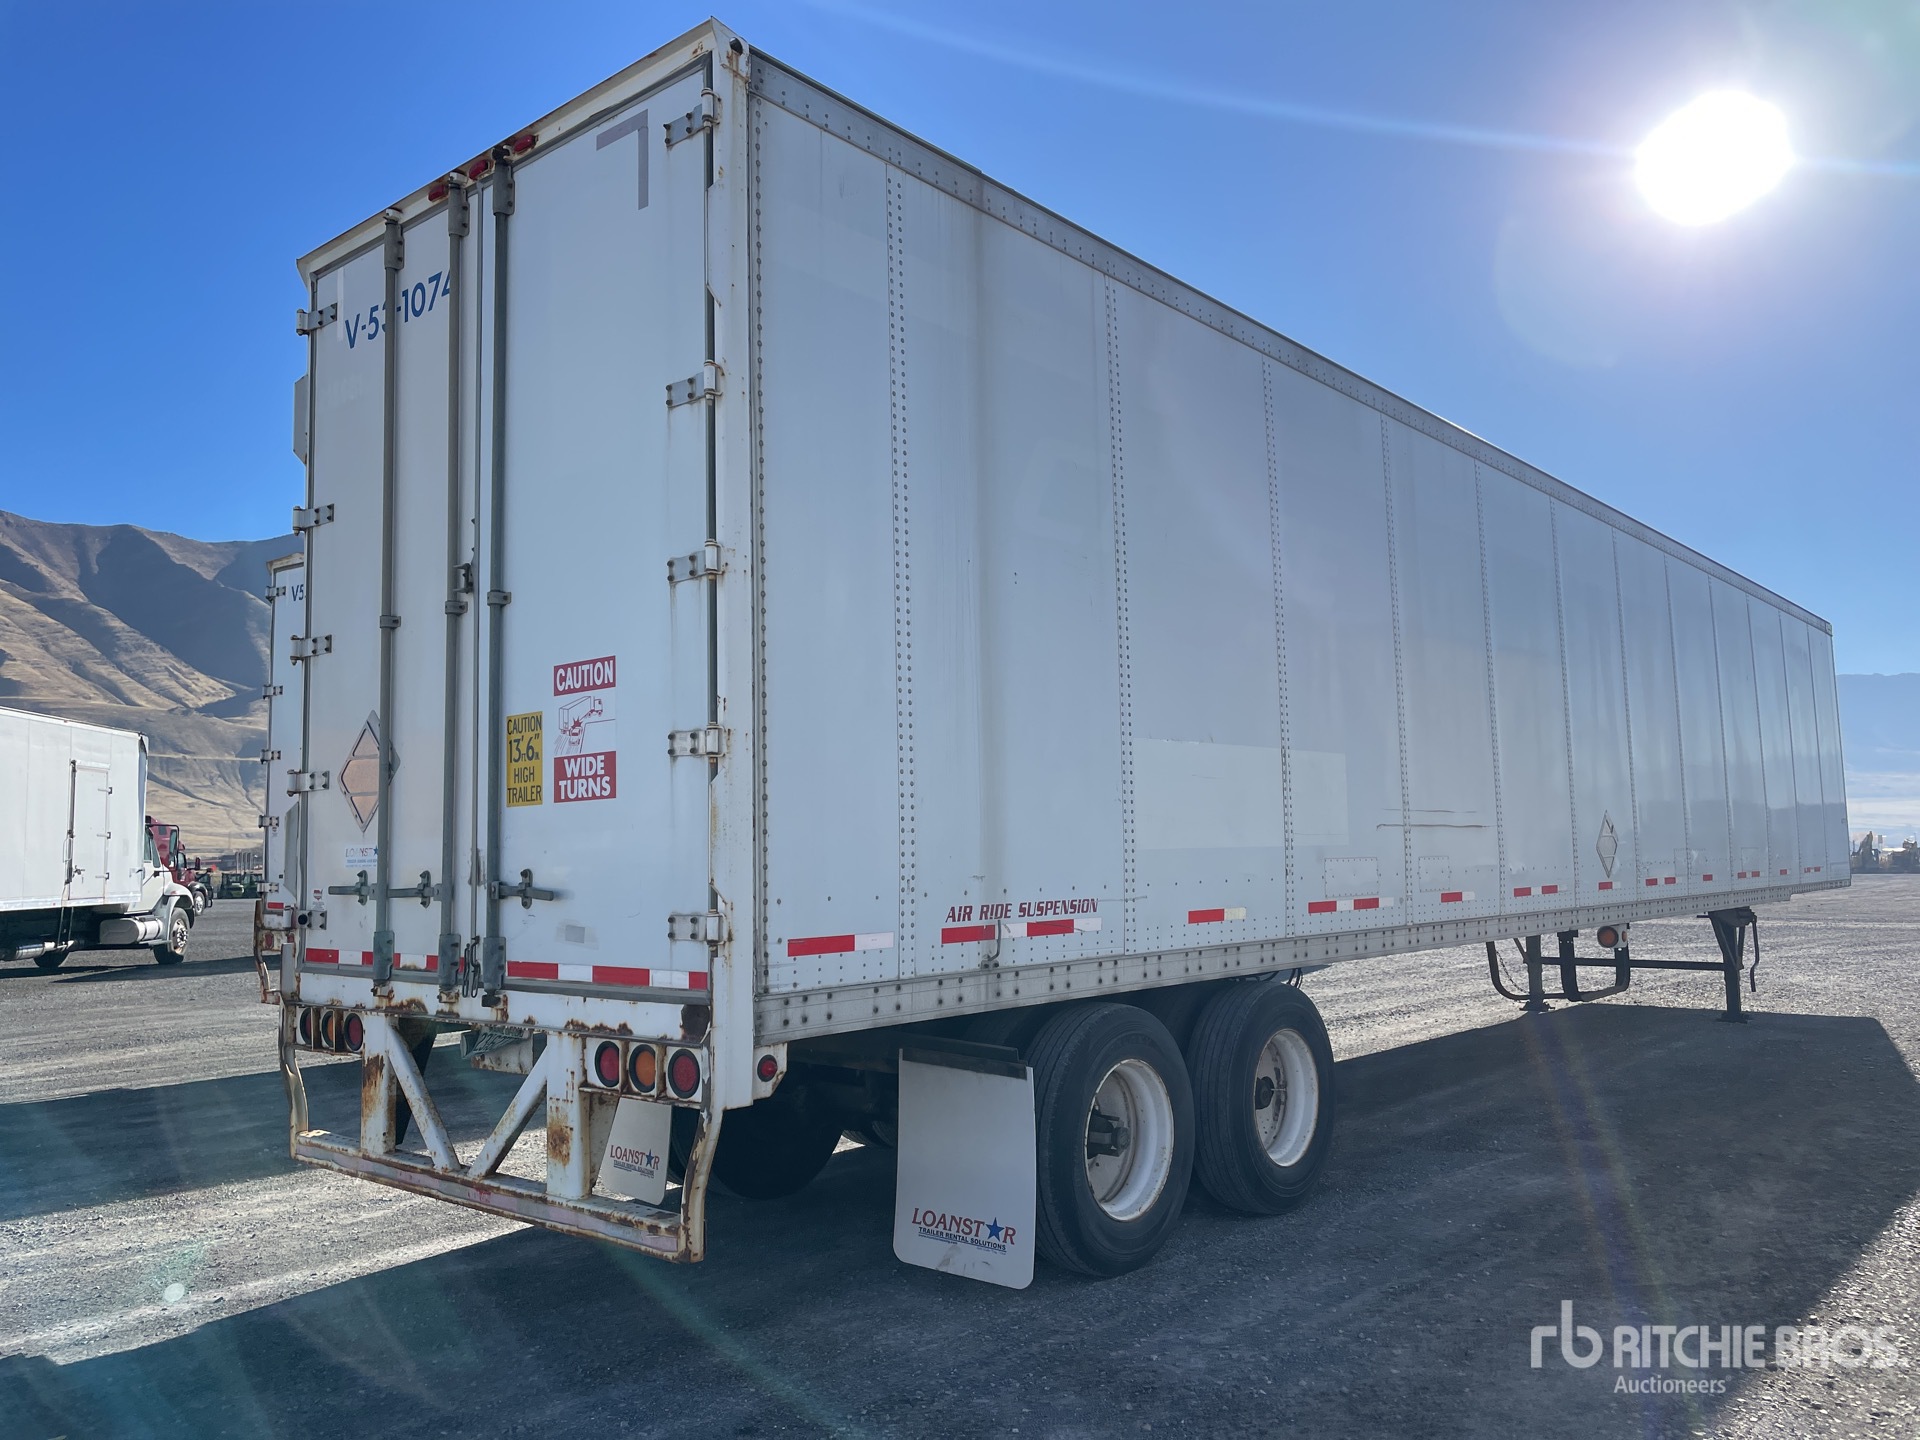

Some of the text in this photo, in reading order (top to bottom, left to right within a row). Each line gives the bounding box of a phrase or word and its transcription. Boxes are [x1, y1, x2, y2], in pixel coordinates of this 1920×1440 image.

[556, 660, 613, 692] CAUTION
[507, 715, 542, 735] CAUTION
[513, 766, 535, 784] HIGH
[564, 755, 605, 778] WIDE
[507, 785, 542, 804] TRAILER
[559, 776, 611, 800] TURNS
[945, 898, 1098, 923] AIR RIDE SUSPENSION
[919, 1227, 944, 1237] TRAILER
[946, 1232, 969, 1243] RENTAL
[971, 1238, 1006, 1250] SOLUTIONS
